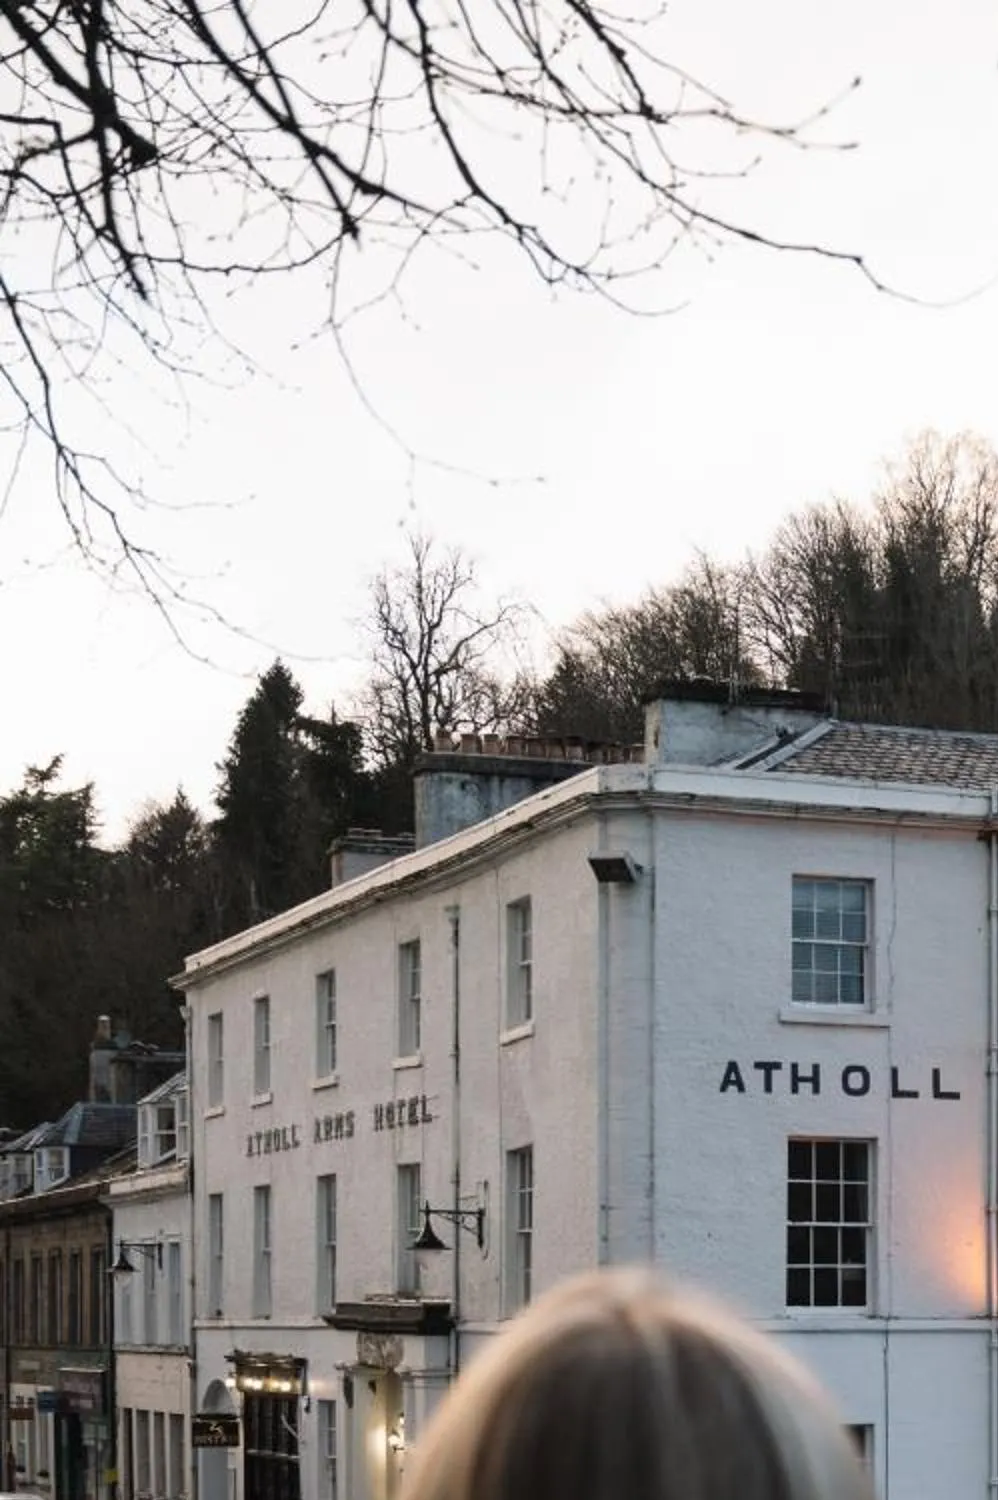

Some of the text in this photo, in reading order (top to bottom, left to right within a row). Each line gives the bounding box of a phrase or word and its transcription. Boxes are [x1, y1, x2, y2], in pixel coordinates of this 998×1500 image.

[719, 1060, 961, 1100] ATHOLL
[246, 1093, 434, 1158] ATHOLL ARMS HOTEL
